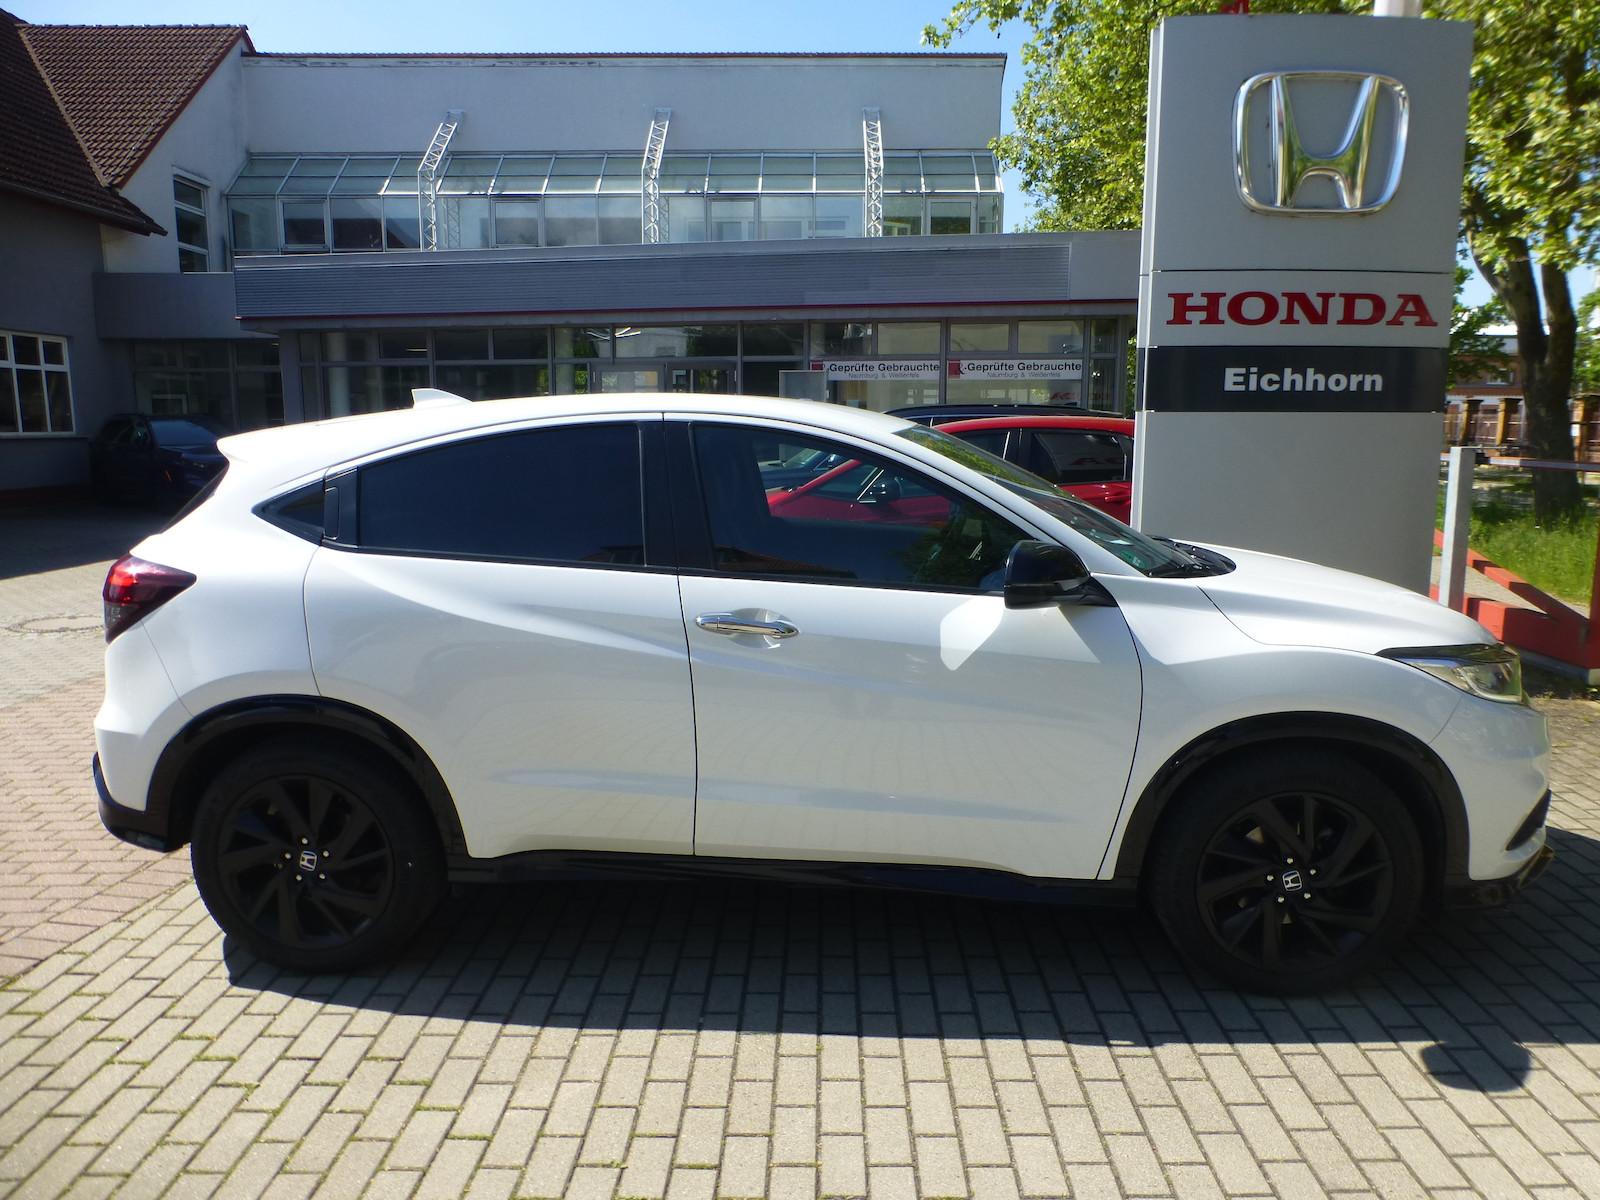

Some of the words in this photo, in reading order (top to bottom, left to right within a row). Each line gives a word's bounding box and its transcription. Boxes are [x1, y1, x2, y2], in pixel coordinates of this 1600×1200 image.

[1166, 291, 1438, 327] HONDA
[829, 363, 875, 373] Geprüfte
[878, 363, 940, 372] Gebrauchte
[967, 362, 1014, 373] Geprüfte
[1017, 362, 1081, 371] Gebrauchte
[1224, 367, 1383, 392] Eichhorn
